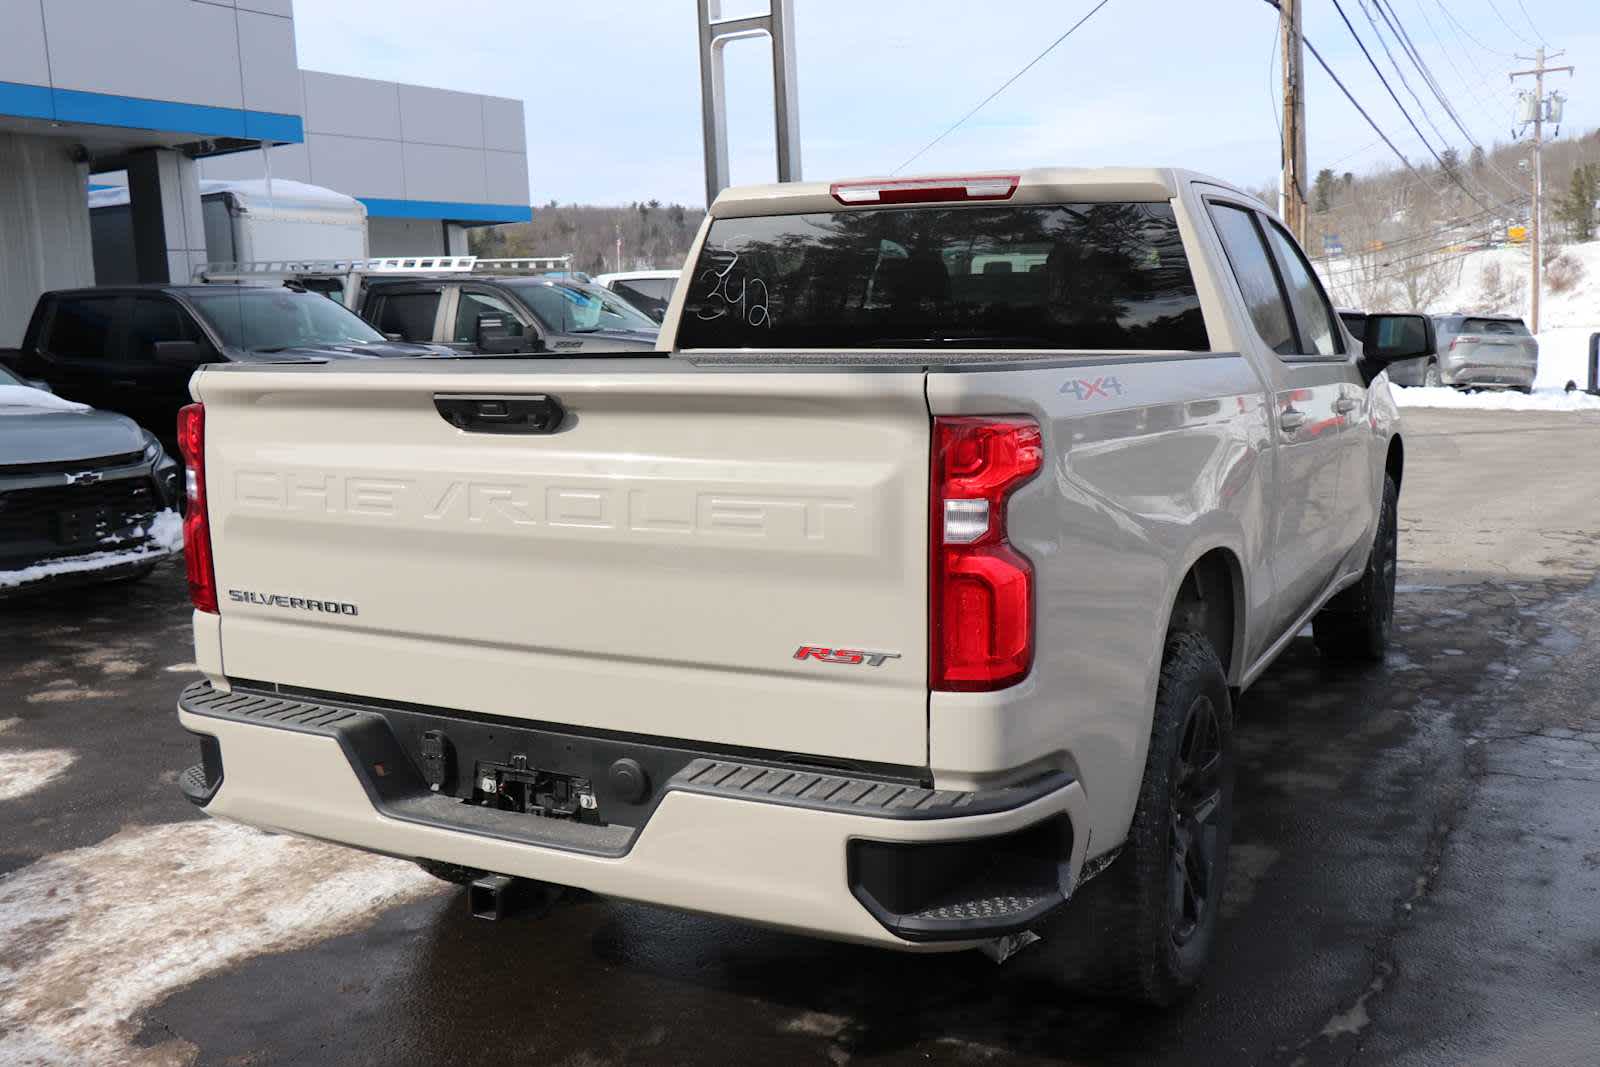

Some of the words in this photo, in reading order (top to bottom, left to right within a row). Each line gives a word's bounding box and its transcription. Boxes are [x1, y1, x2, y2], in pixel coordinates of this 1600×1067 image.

[233, 470, 857, 540] CHEVROLET
[228, 588, 359, 616] SILVERADO
[793, 644, 902, 668] RST
